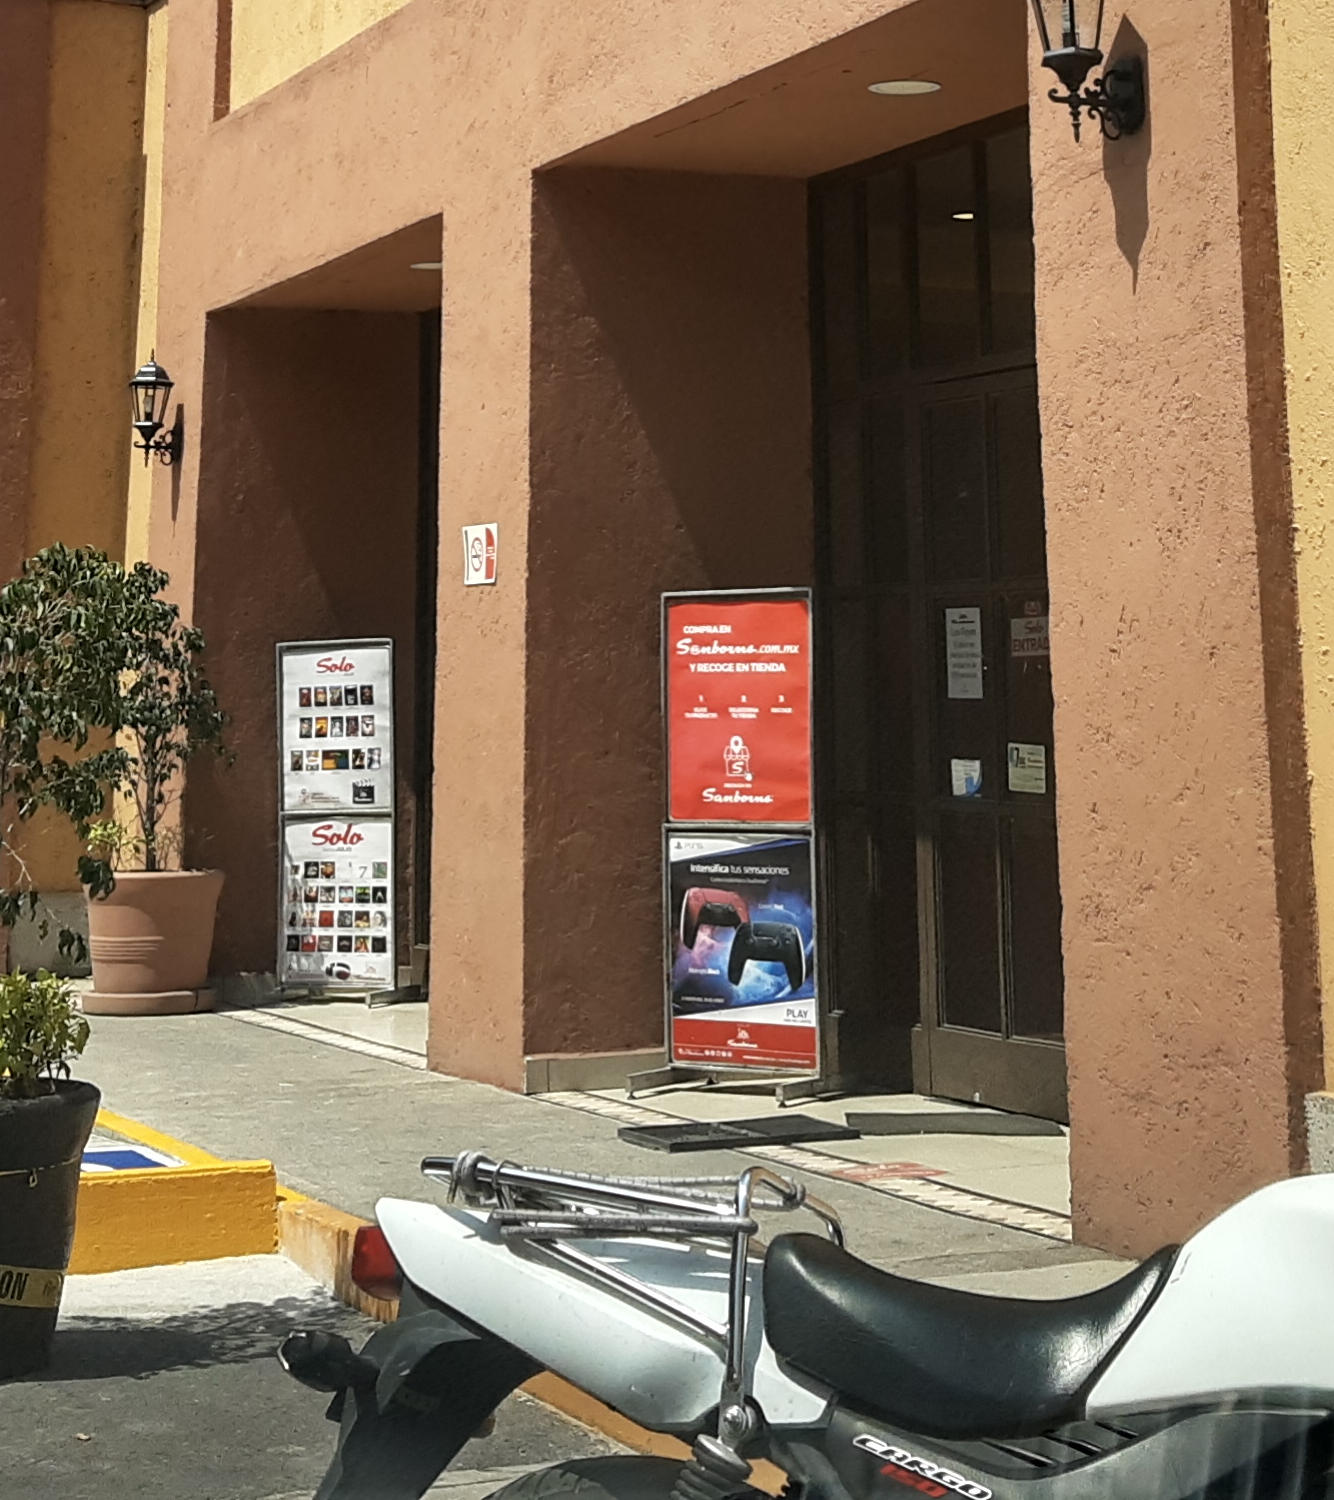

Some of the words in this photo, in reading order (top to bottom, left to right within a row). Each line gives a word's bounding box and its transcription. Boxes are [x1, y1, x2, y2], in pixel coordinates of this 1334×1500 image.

[682, 625, 718, 634] COMPRA
[316, 656, 356, 674] Solo
[689, 663, 696, 672] Y
[697, 663, 734, 672] RECOGE
[736, 663, 749, 672] EN
[750, 663, 786, 672] TIENDA
[702, 787, 774, 803] Sanborns
[312, 823, 364, 846] Solo
[743, 865, 789, 875] sensaciones
[786, 1008, 808, 1019] PLAY
[853, 1433, 993, 1500] CARGO
